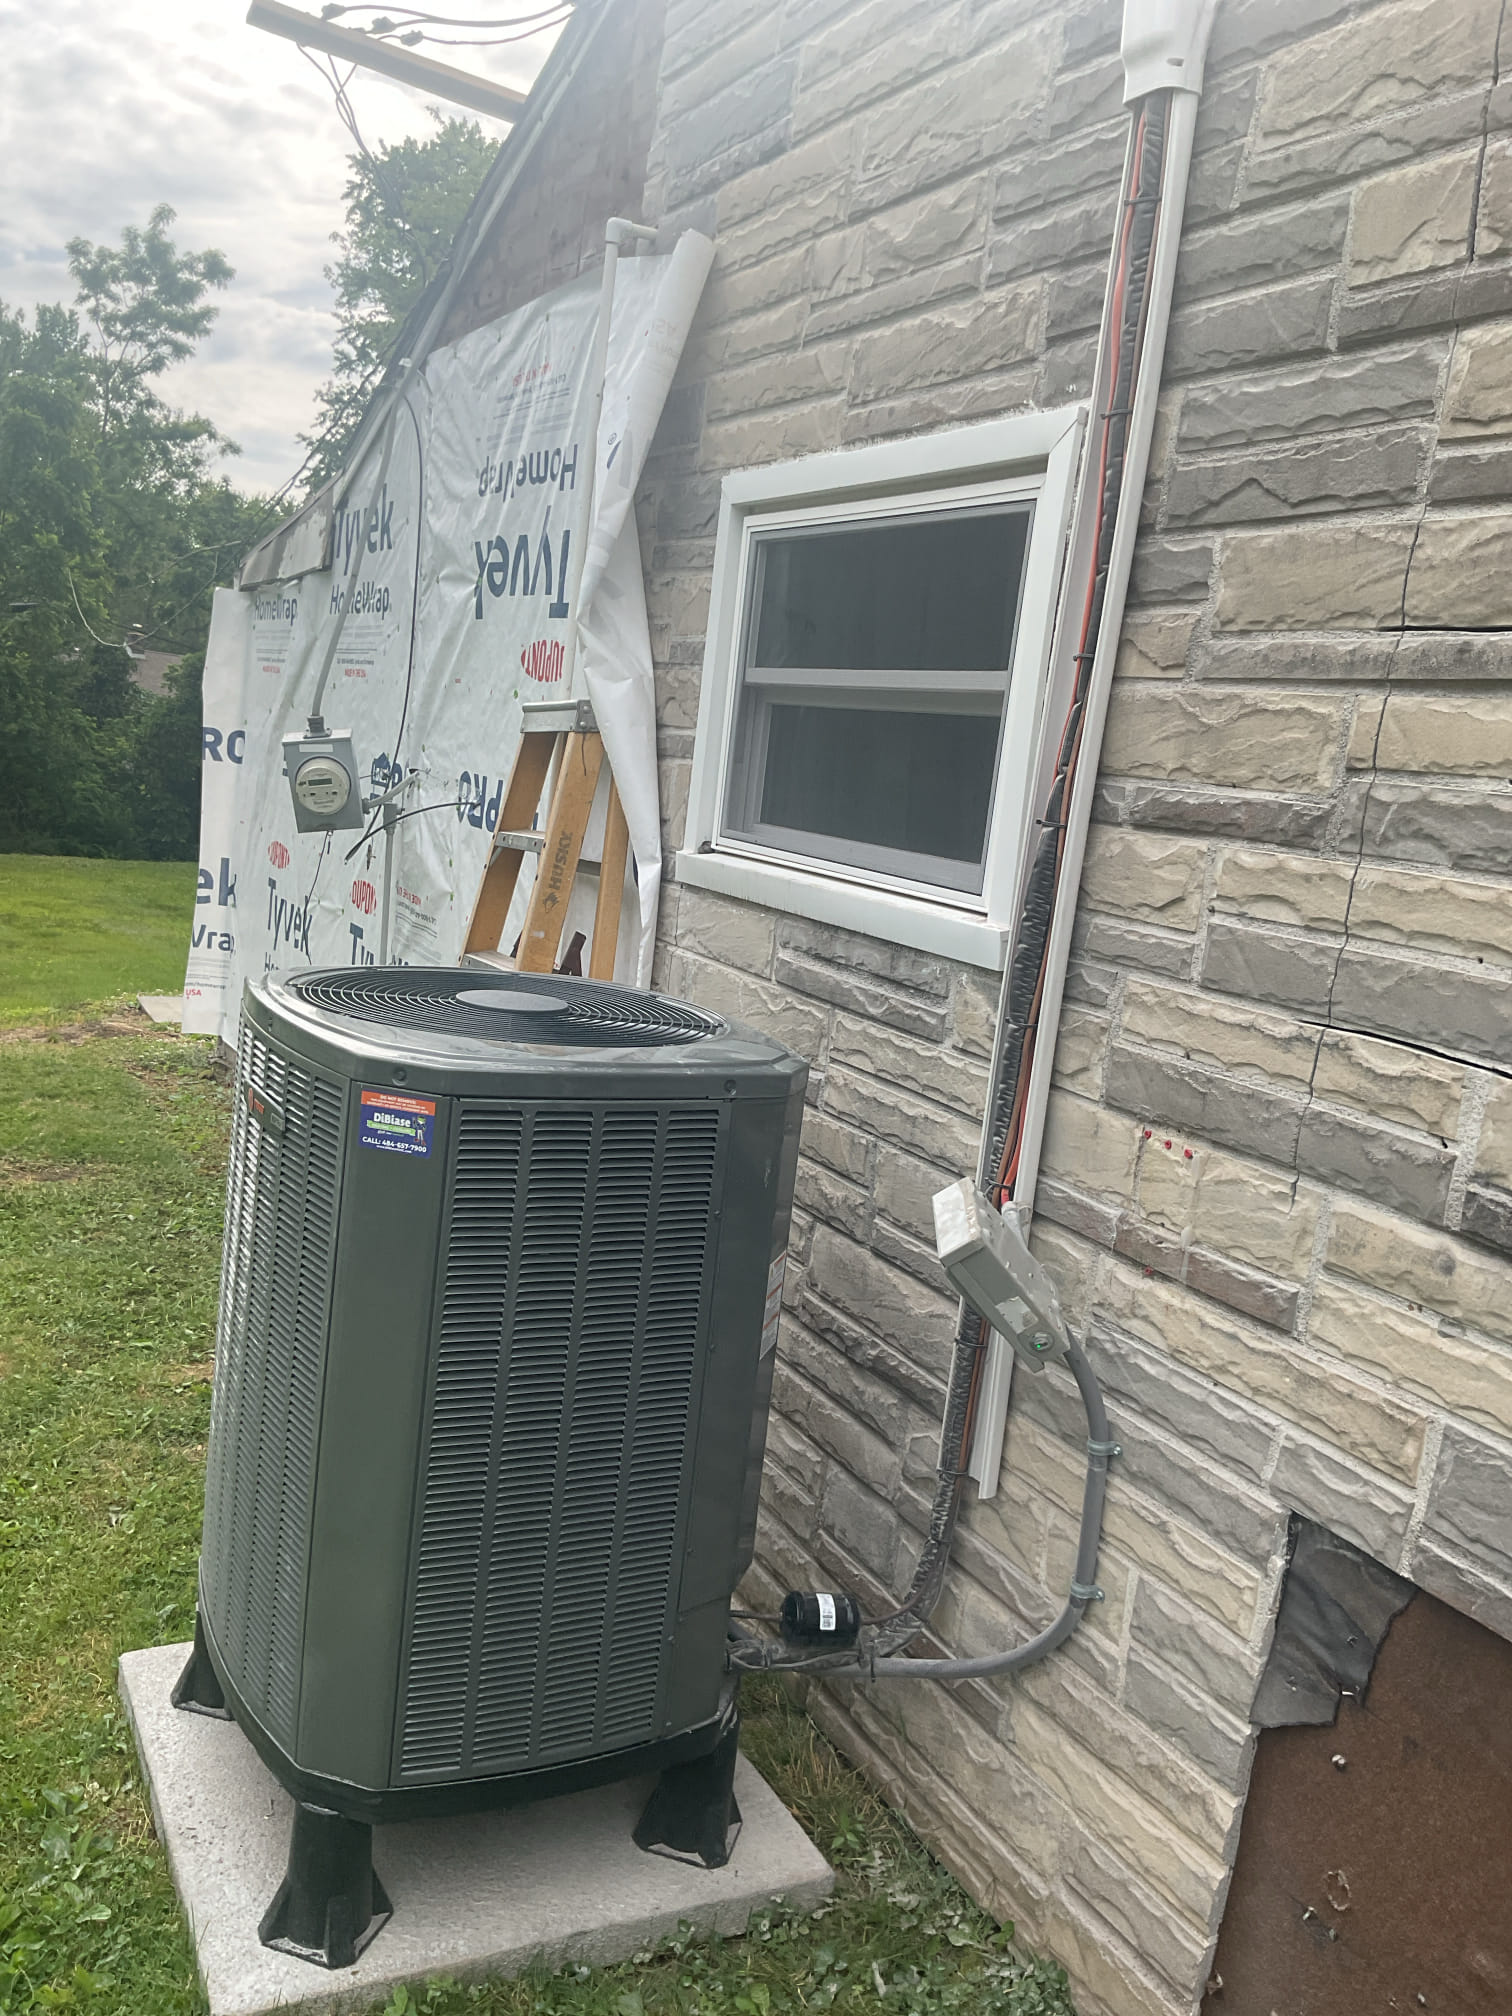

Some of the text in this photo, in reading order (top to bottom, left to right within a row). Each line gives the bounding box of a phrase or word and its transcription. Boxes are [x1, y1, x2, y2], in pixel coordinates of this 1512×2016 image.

[473, 504, 571, 620] Tyvek
[548, 830, 574, 891] HUSKY
[373, 1112, 411, 1128] DiBiase
[362, 1136, 382, 1145] CALL:
